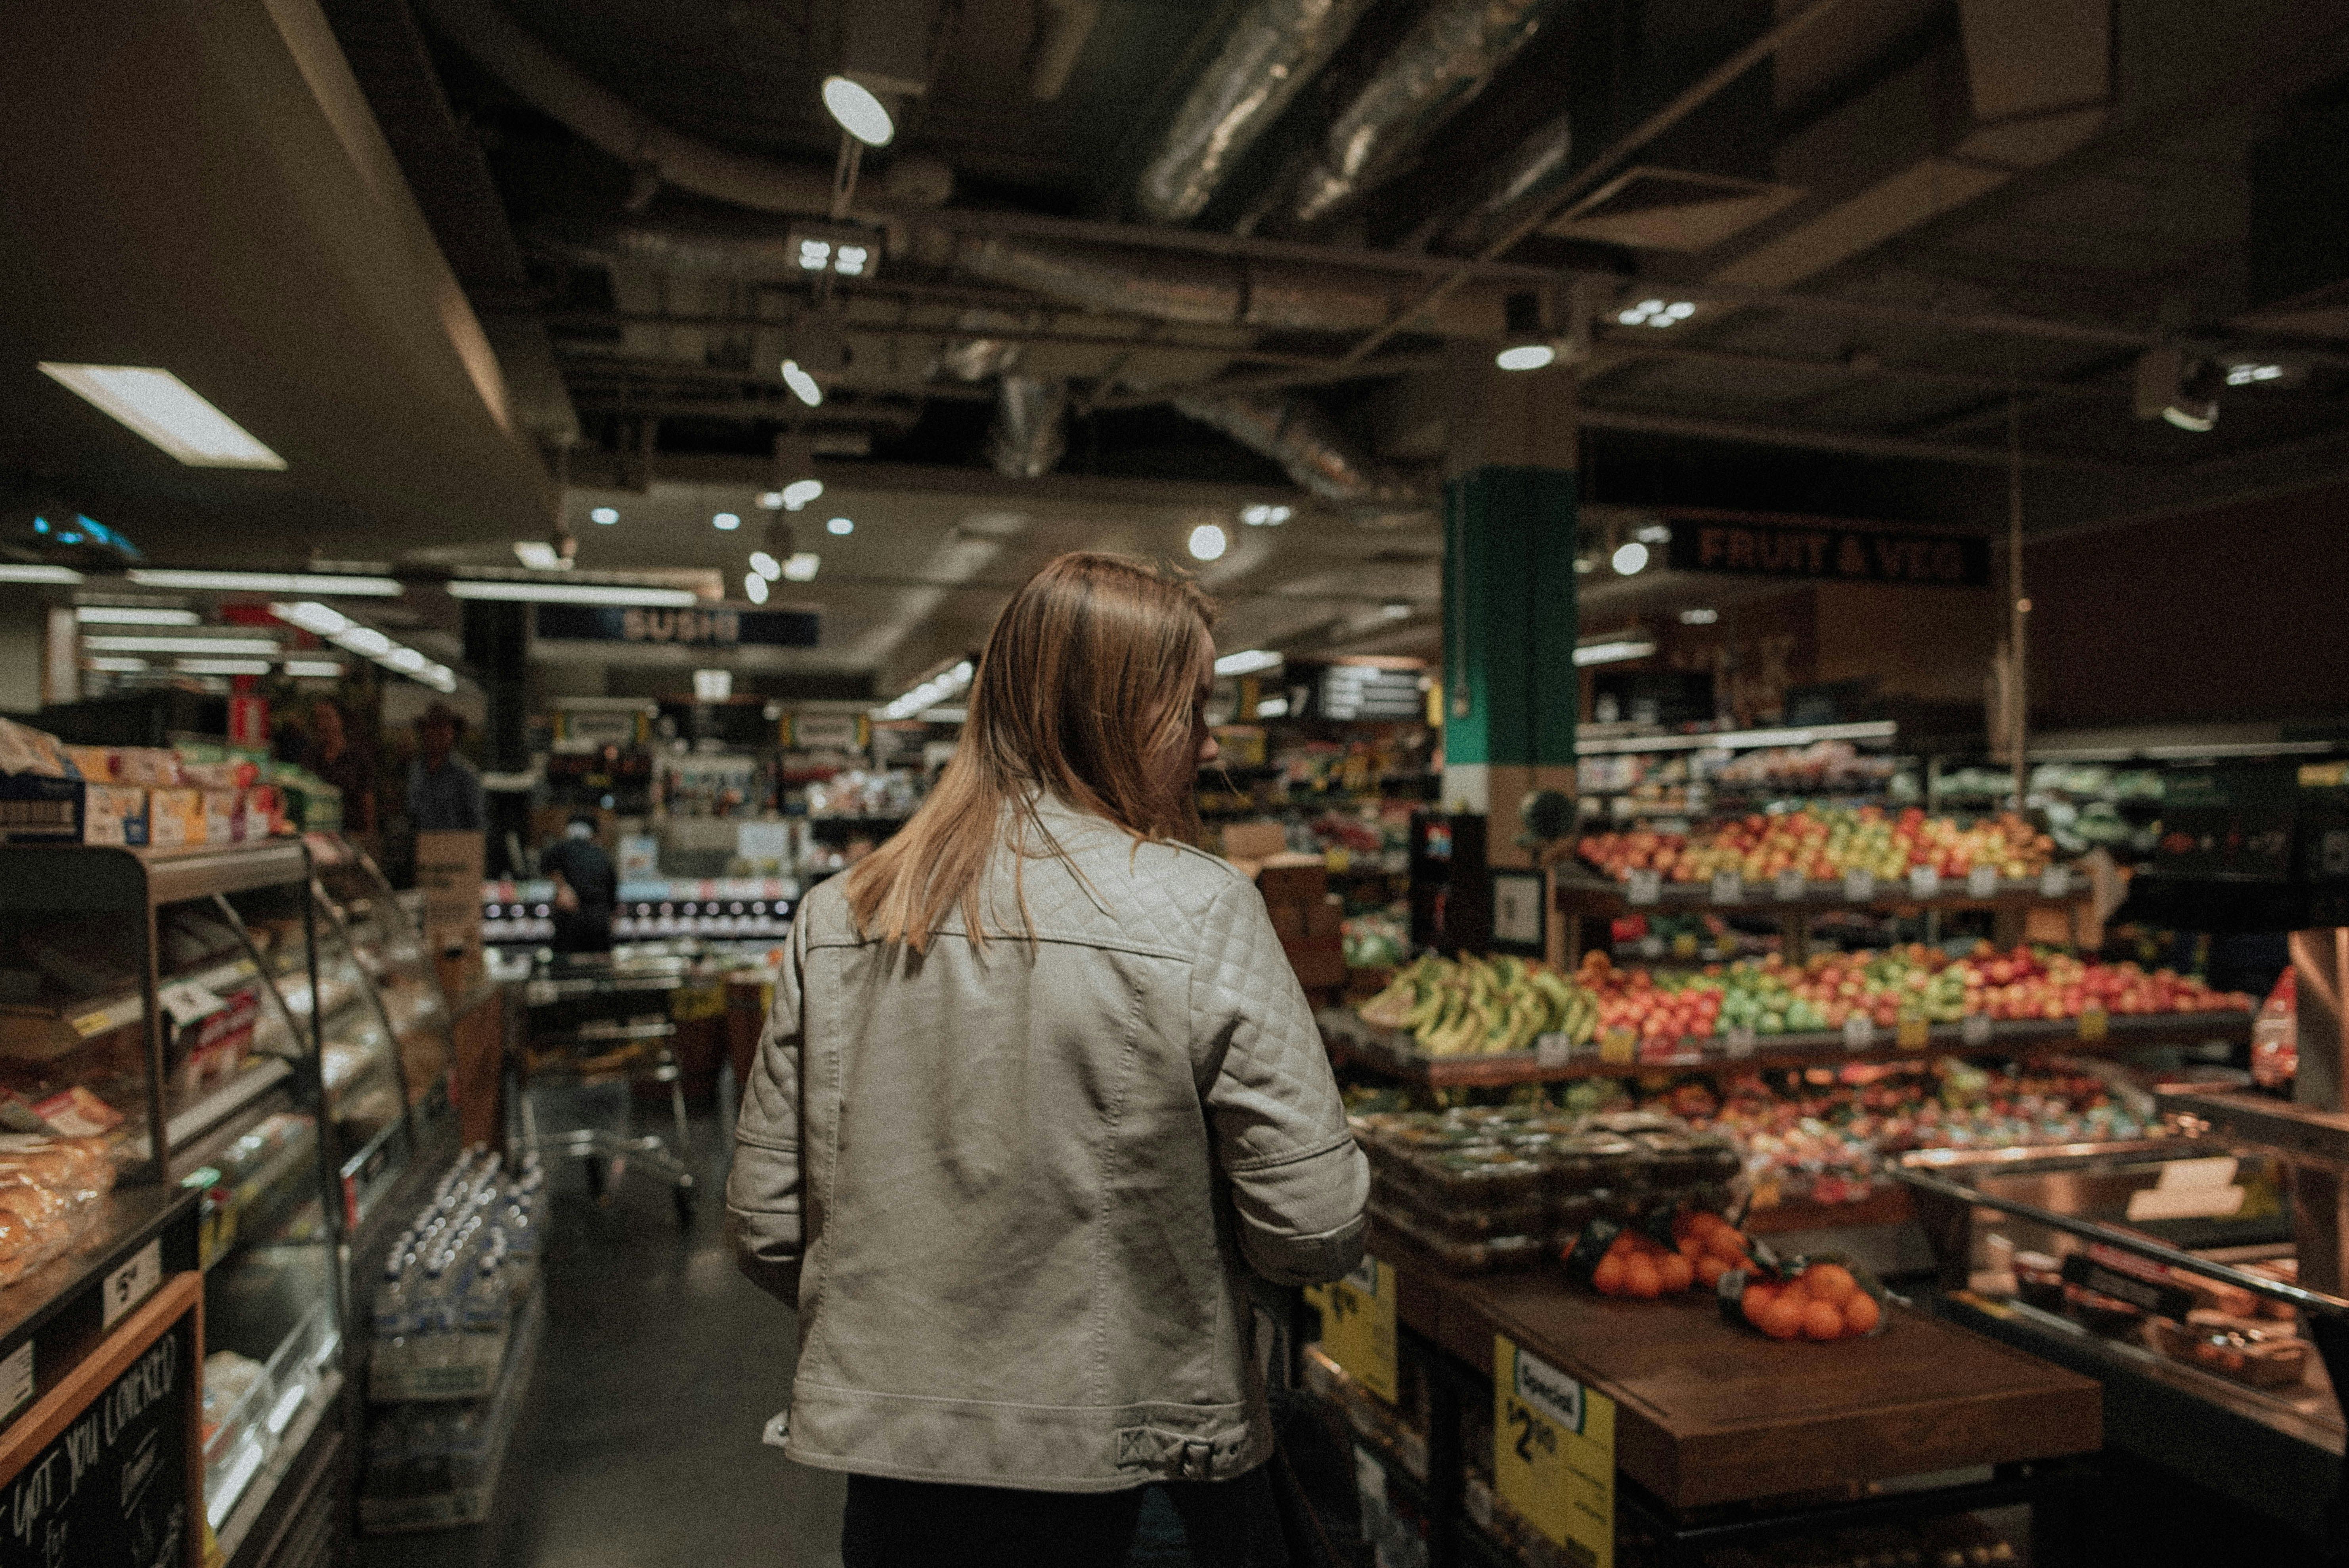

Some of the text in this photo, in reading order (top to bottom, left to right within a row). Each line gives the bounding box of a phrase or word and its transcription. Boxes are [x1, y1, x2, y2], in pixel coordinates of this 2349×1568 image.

[1699, 527, 1829, 574] FRUIT
[1876, 535, 1963, 581] VEG
[623, 609, 740, 641] SUSHI
